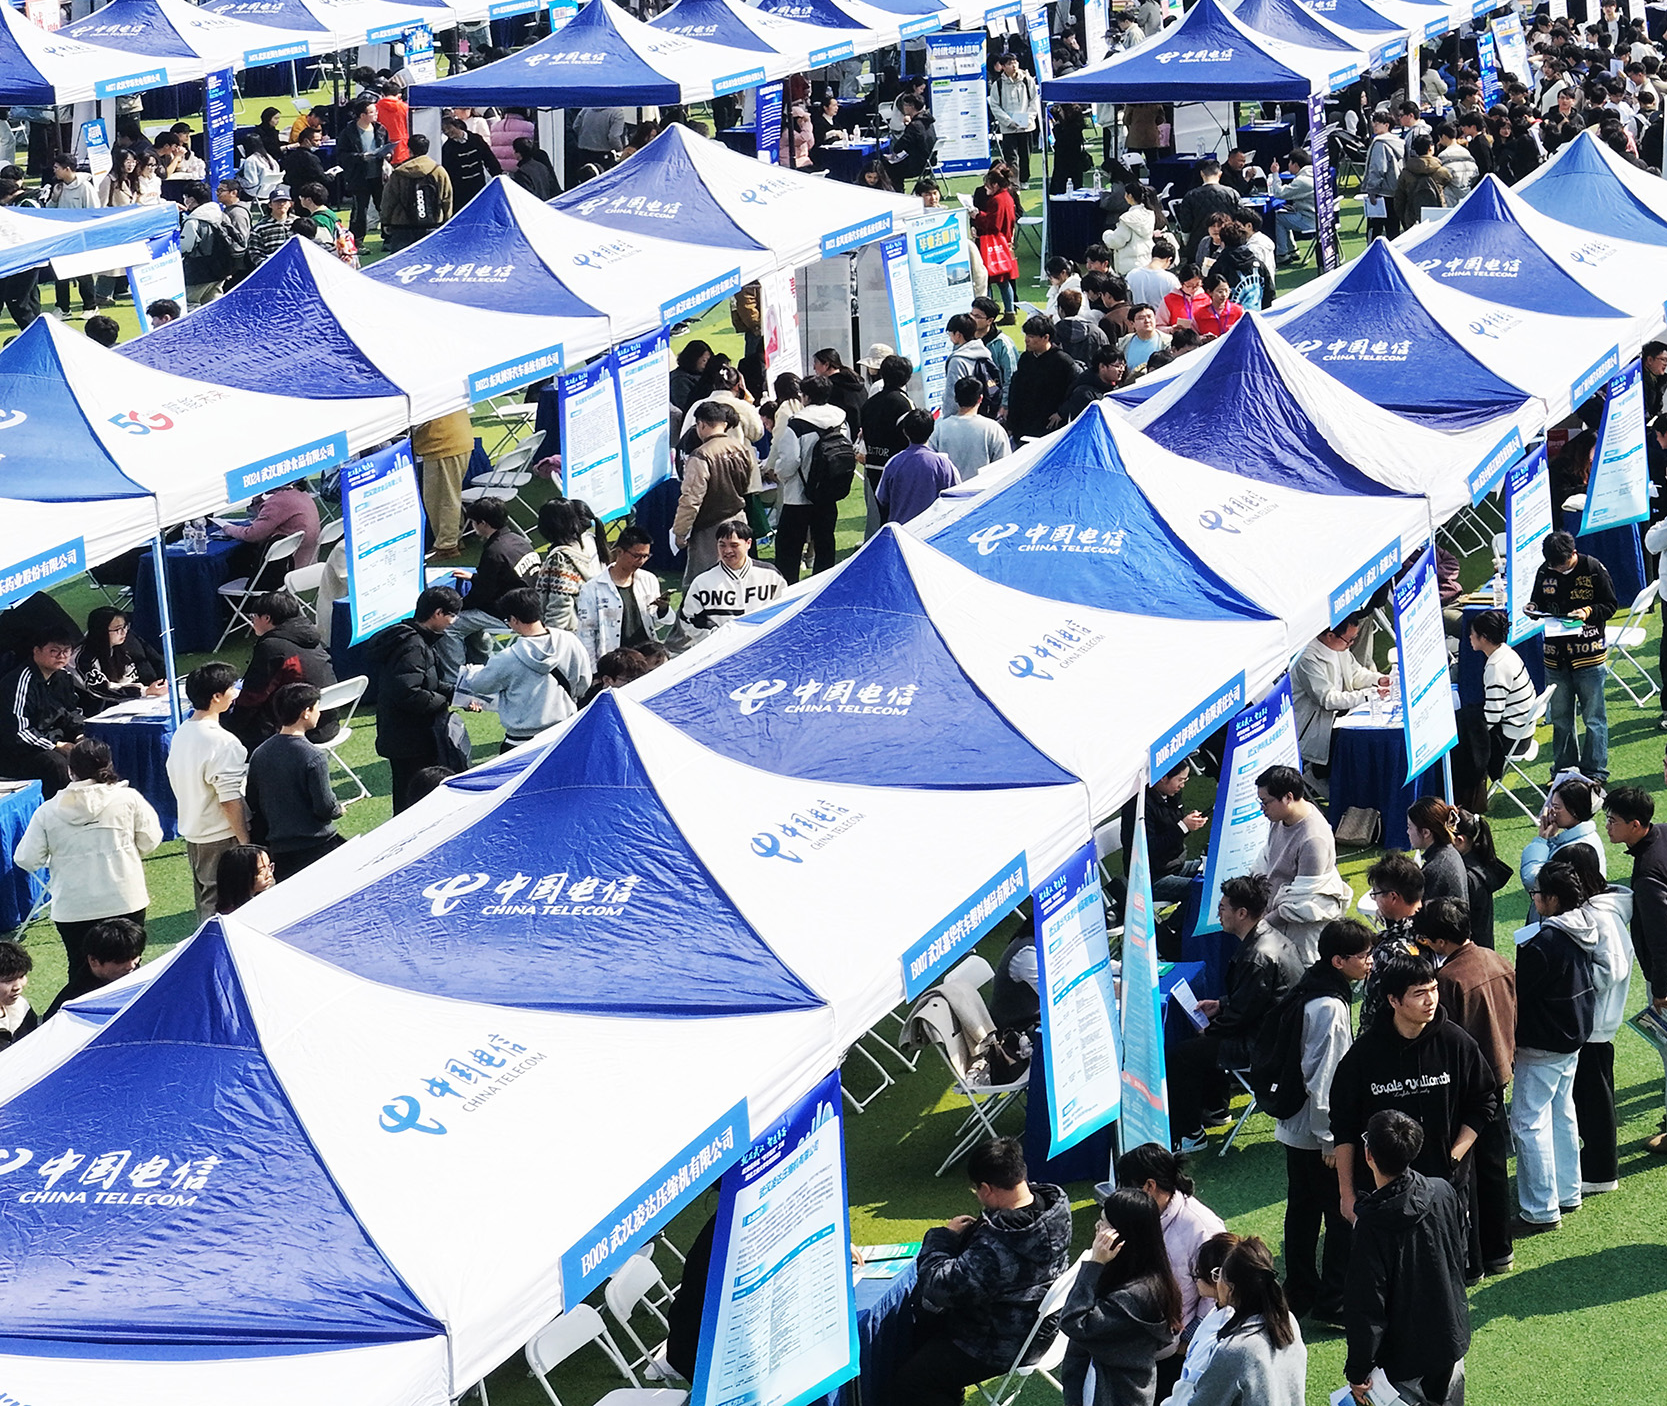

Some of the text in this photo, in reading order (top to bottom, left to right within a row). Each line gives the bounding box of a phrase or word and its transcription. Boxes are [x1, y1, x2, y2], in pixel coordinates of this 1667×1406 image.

[96, 23, 145, 35] 中国电信
[671, 23, 718, 36] 中国电信
[554, 51, 607, 64] 中国电信
[1182, 48, 1234, 60] 中国电信
[605, 207, 677, 220] CHINA TELECOM
[611, 196, 681, 215] 中国电信
[434, 262, 516, 281] 中国电信
[1441, 268, 1519, 278] CHINA TELECOM
[1444, 256, 1524, 273] 中国电信
[429, 274, 508, 284] CHINA TELECOM
[1326, 338, 1413, 356] 中国电信
[1322, 352, 1408, 363] CHINA TELECOM
[107, 409, 175, 438] 5G
[1023, 523, 1126, 545] 中国电信
[1018, 542, 1122, 556] CHINA TELECOM
[1031, 617, 1093, 661] 中国电信
[792, 679, 919, 704] 中国电信
[784, 703, 908, 716] CHINA TELECOM
[1155, 738, 1171, 766] B006
[781, 797, 850, 840] 中国电信
[494, 871, 642, 903] 中国电信
[481, 904, 625, 917] CHINA TELECOM
[911, 953, 929, 980] B007
[928, 867, 1024, 961] 武汉嘉华汽车塑料制品有限公司
[422, 1032, 528, 1100] 中国电信
[462, 1051, 547, 1113] CHINA TELECOM
[38, 1148, 223, 1192] 中国电信
[19, 1190, 198, 1207] CHINA TELECOM
[580, 1244, 609, 1278] B008
[607, 1125, 735, 1255] 武汉凌达压缩机有限公司
